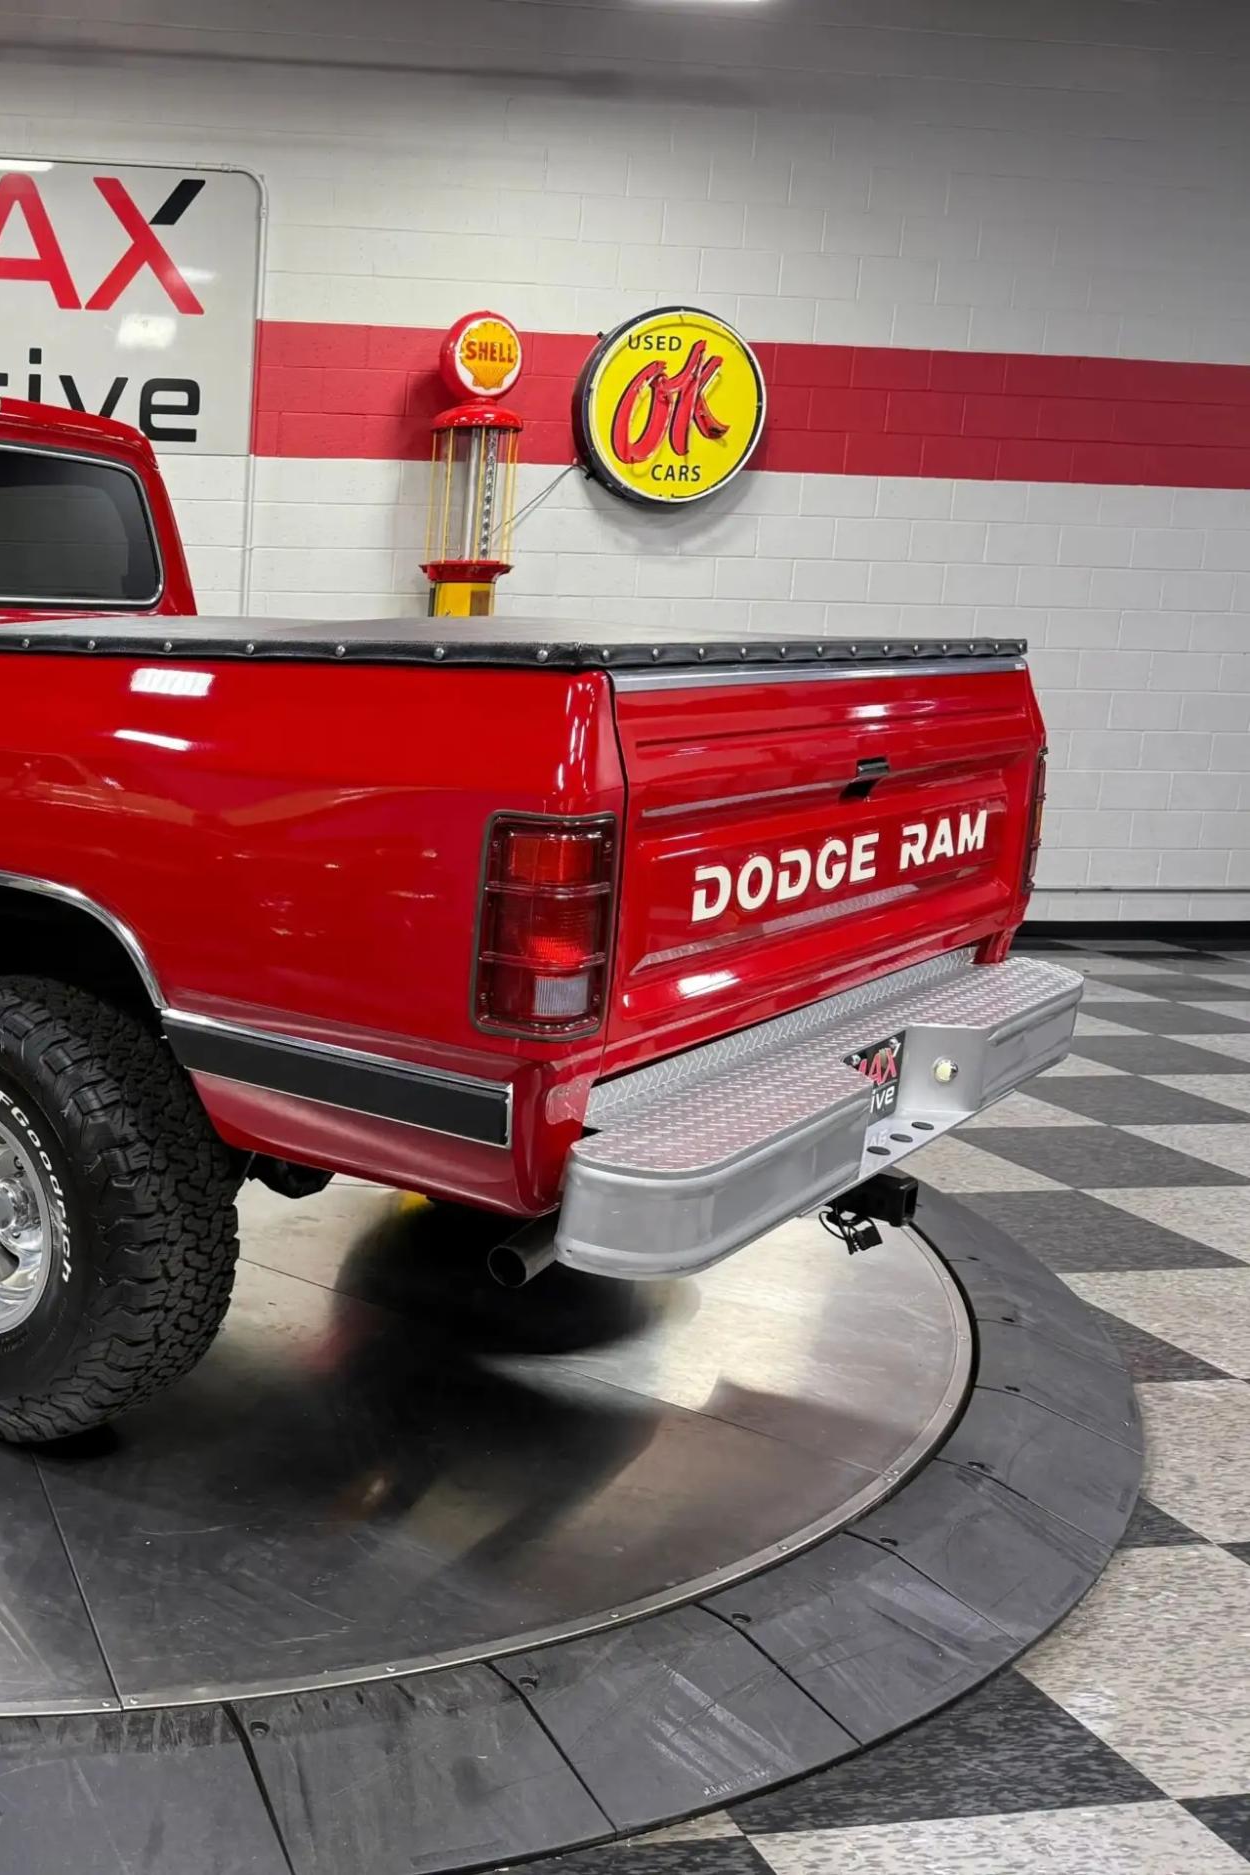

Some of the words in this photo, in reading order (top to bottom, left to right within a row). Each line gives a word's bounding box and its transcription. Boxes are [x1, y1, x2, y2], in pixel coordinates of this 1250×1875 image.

[465, 340, 515, 364] SHELL
[628, 334, 682, 352] USED
[610, 339, 730, 465] OK
[651, 464, 701, 482] CARS
[691, 833, 880, 923] DODGE
[900, 810, 988, 871] RAM
